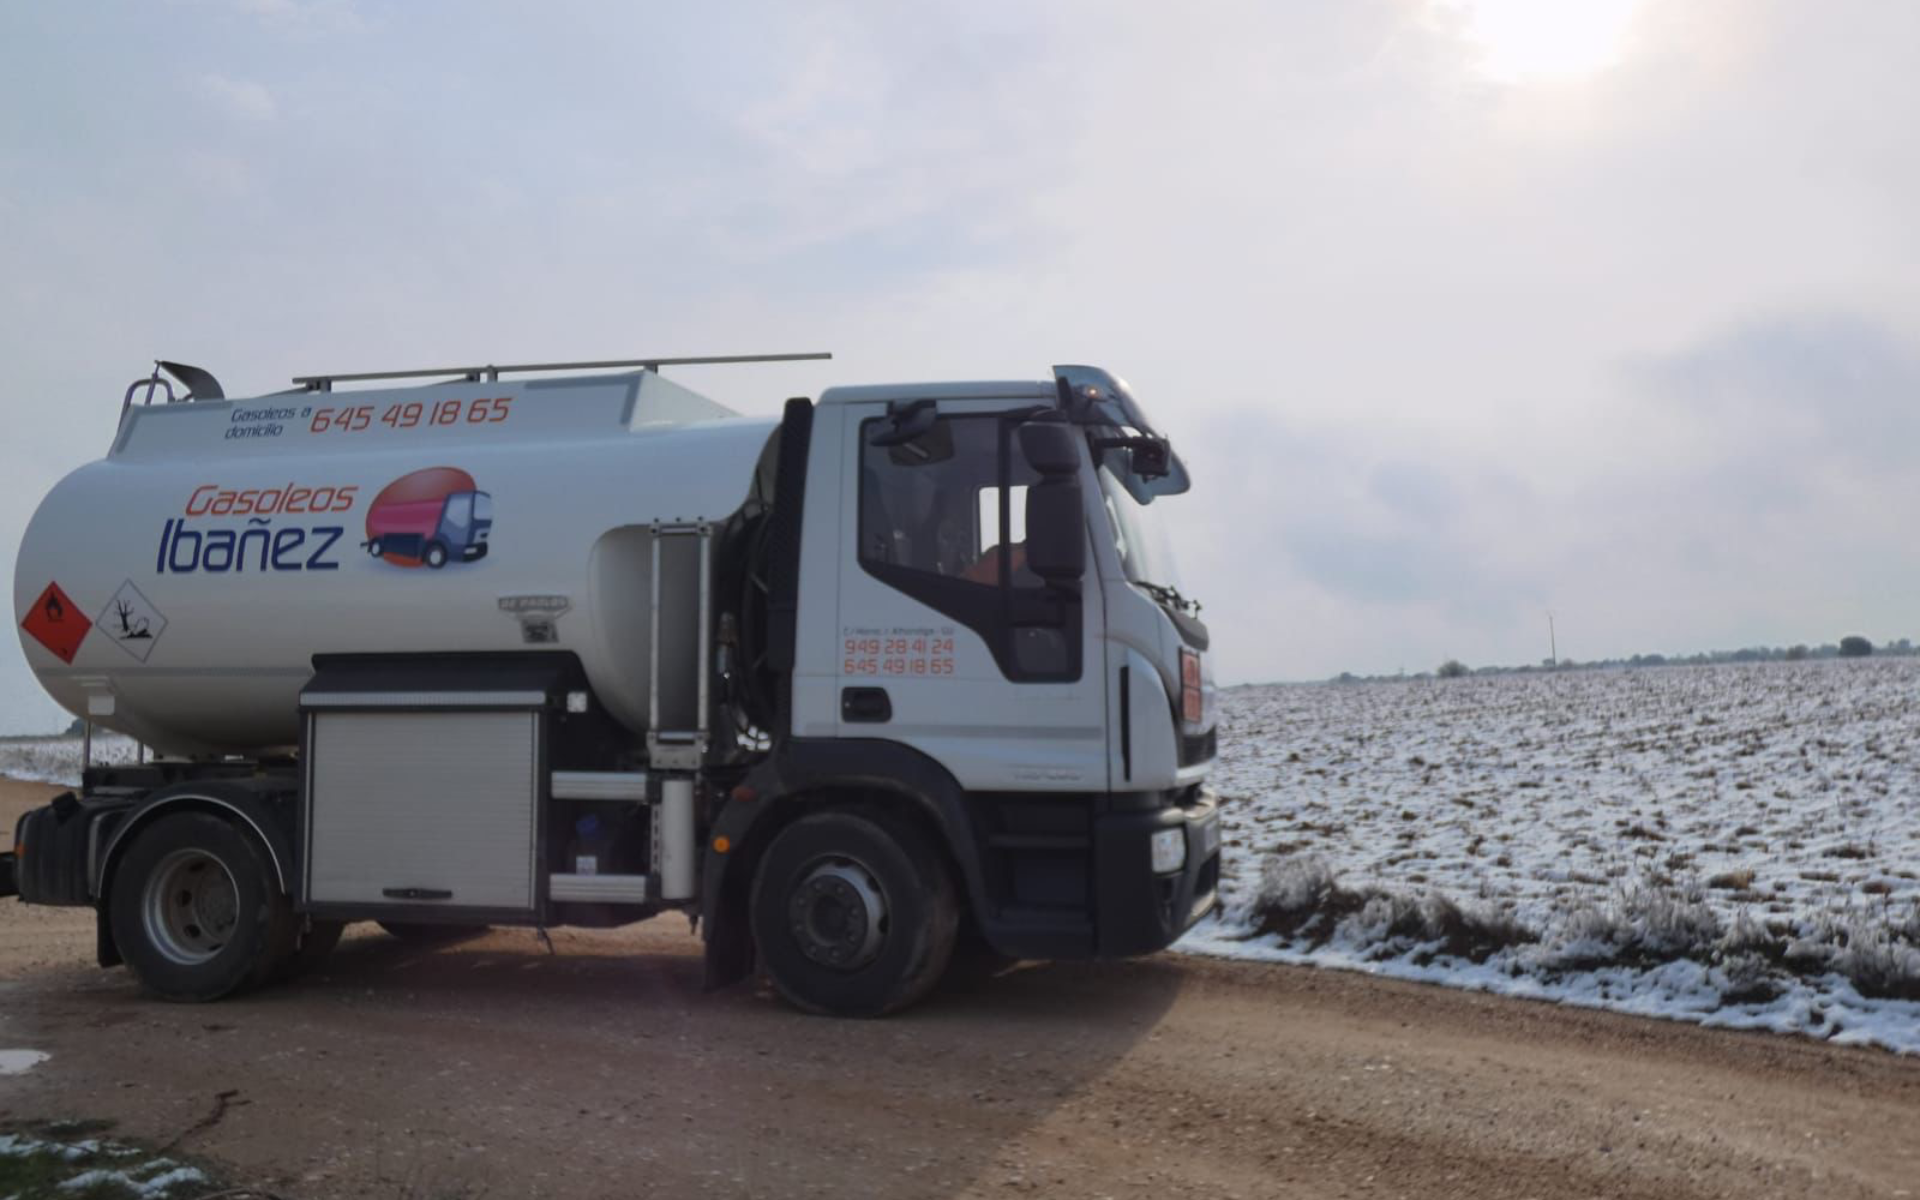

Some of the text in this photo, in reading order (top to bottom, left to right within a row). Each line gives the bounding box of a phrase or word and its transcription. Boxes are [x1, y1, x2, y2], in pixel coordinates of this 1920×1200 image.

[231, 407, 311, 423] Gasoleos a
[310, 397, 513, 433] 645 49 18 65
[225, 424, 284, 440] domicilio
[185, 482, 359, 517] Gasoleos
[156, 517, 344, 574] Ibañez
[844, 638, 955, 655] 949 28 41 24
[844, 658, 954, 675] 645 49 18 65
